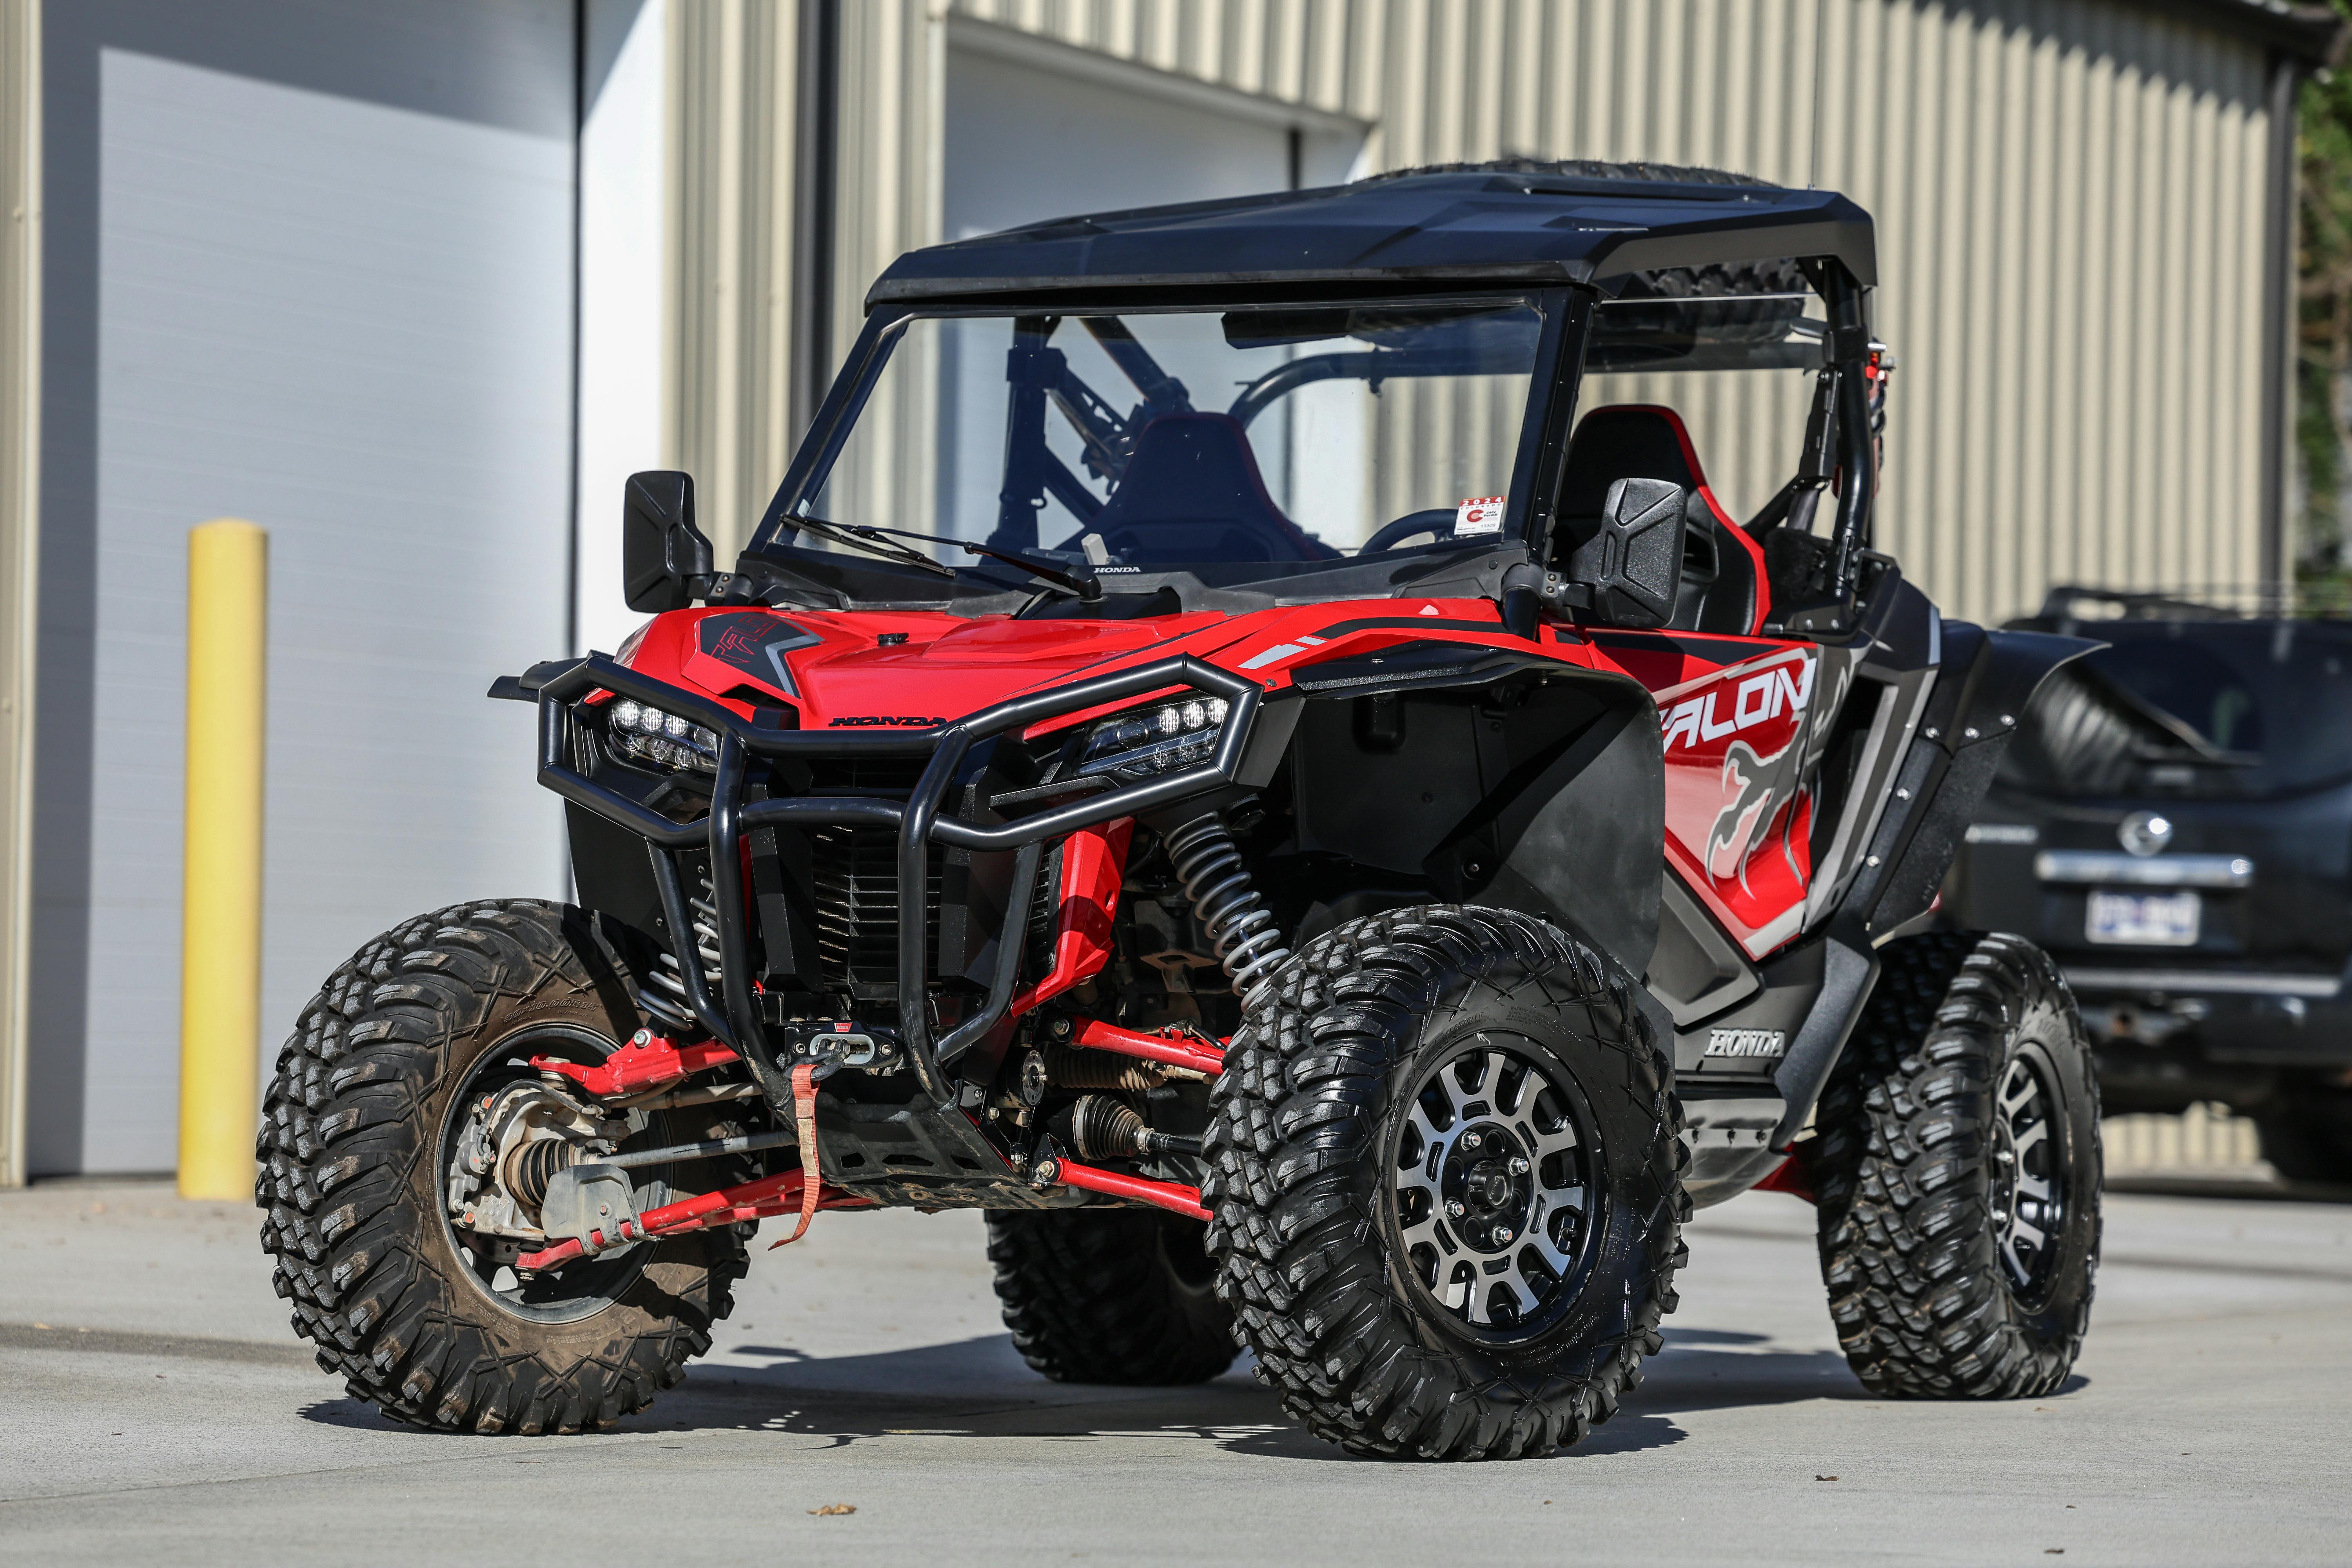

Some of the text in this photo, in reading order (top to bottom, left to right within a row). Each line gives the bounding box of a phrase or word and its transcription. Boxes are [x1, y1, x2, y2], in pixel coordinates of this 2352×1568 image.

[1462, 497, 1502, 506] 2024
[1659, 657, 1817, 754] ALON
[828, 716, 947, 727] HONDA
[1704, 1029, 1785, 1057] HONDA
